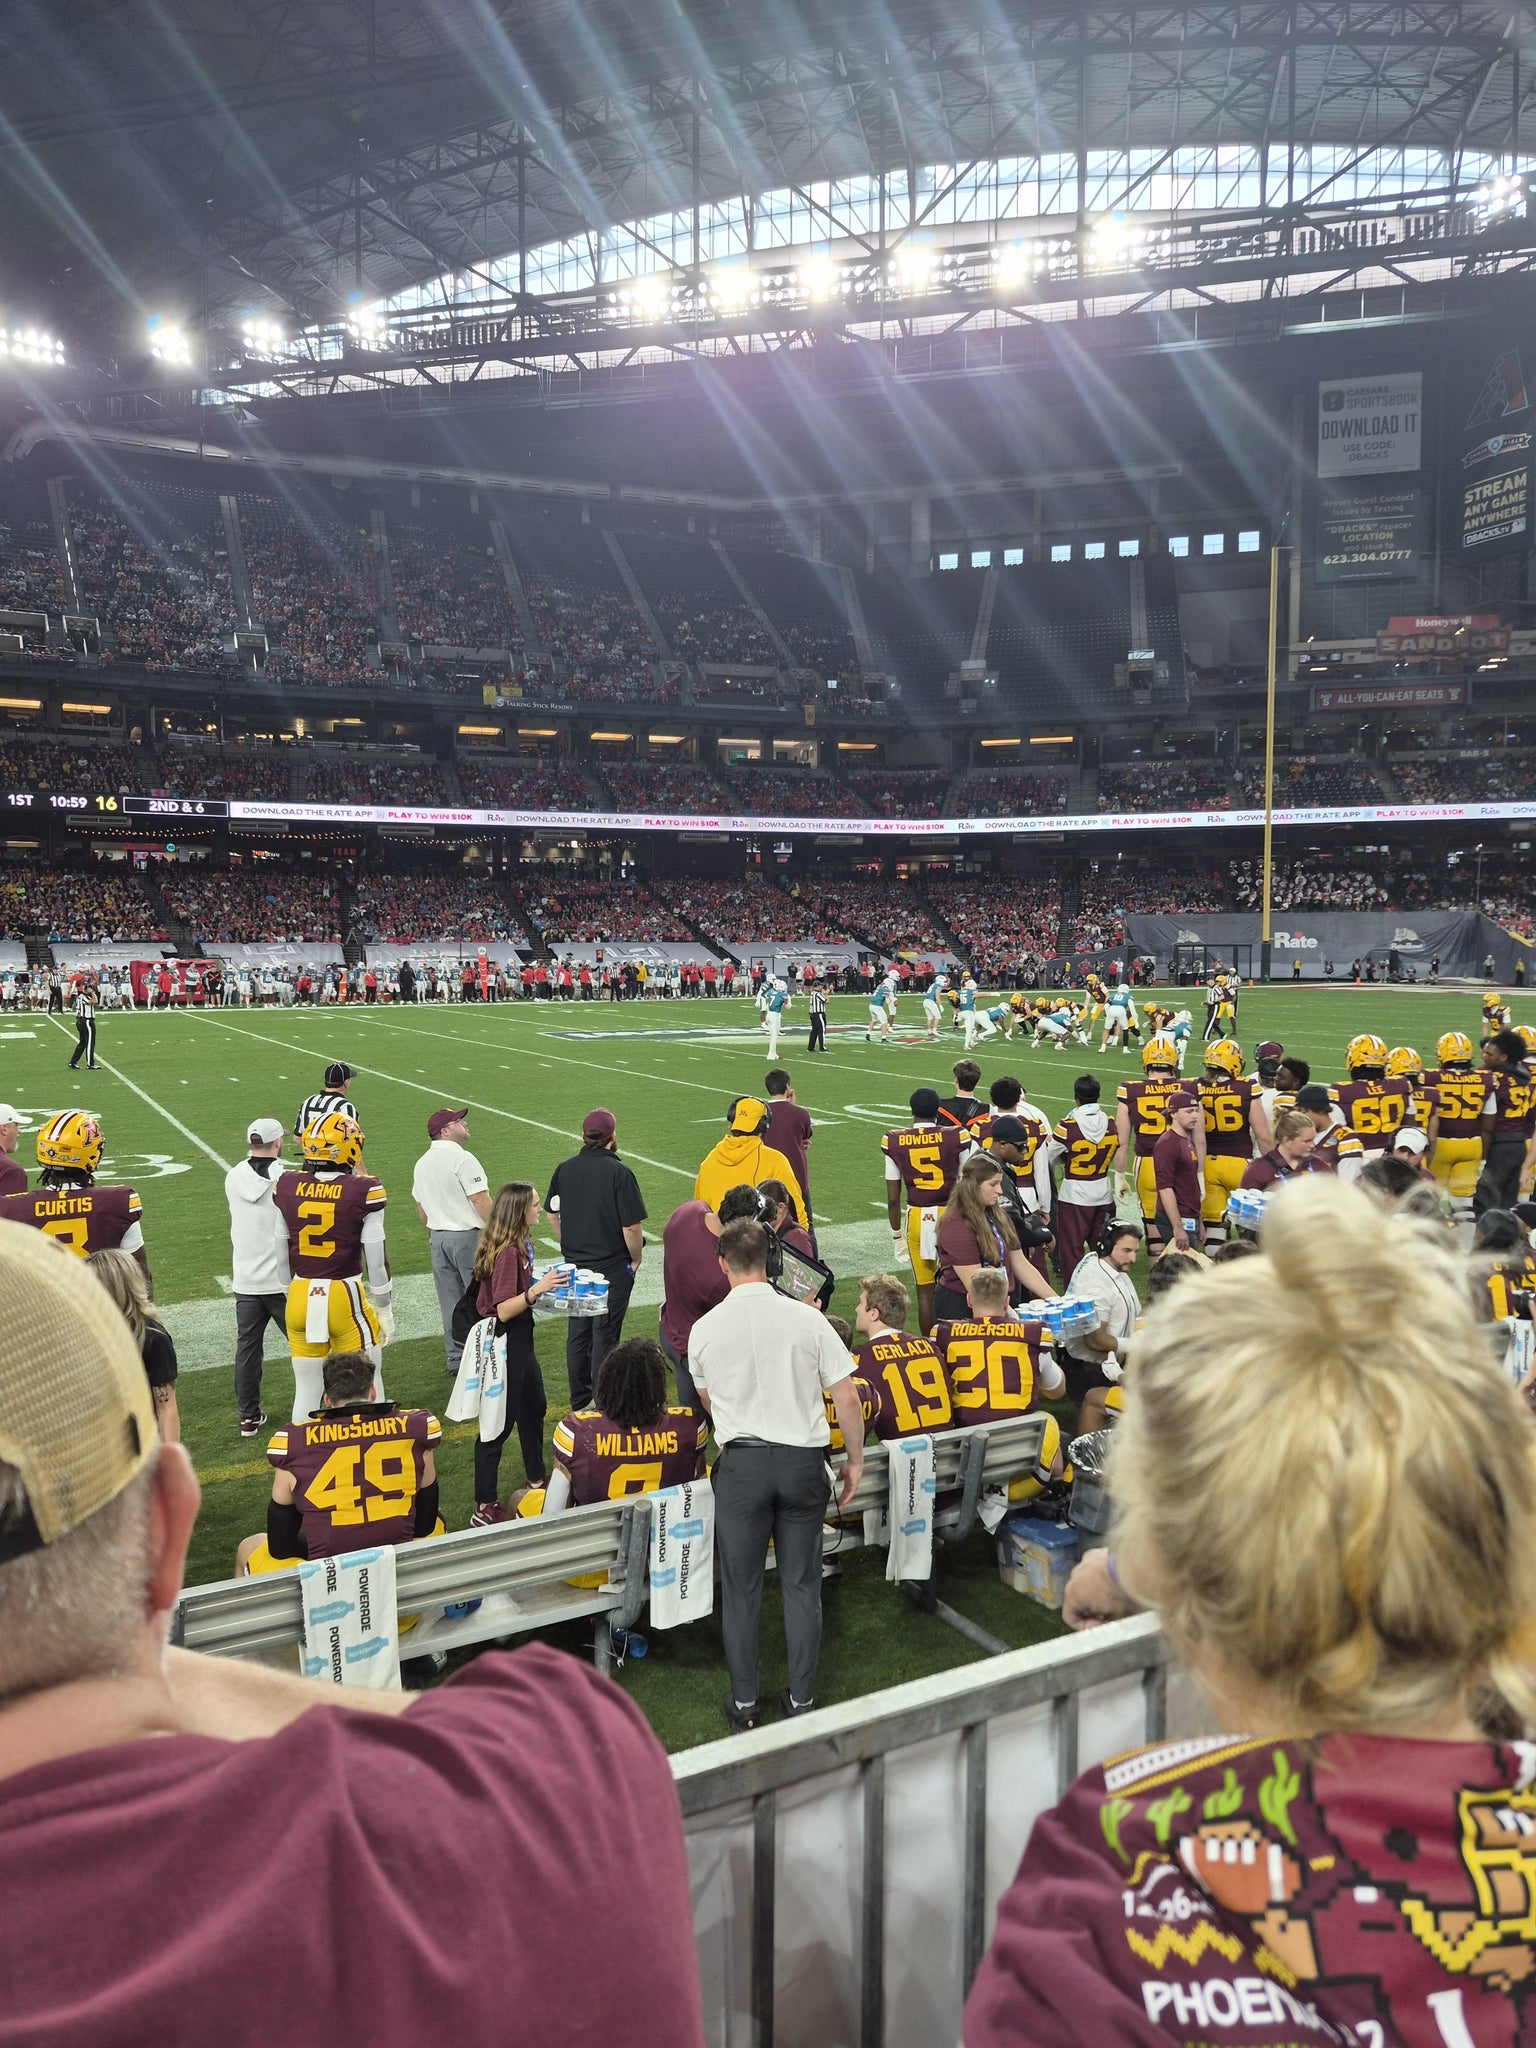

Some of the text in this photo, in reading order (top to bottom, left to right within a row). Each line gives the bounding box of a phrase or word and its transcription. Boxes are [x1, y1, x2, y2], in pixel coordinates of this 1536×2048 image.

[1346, 393, 1418, 410] SPORTSBOOK
[1321, 413, 1418, 440] DOWNLOAD IT
[1343, 442, 1362, 453] USE
[1348, 450, 1390, 461] DBACKS
[1464, 472, 1528, 504] STREAM
[1353, 496, 1377, 505] Guest
[1380, 493, 1415, 503] Conduct
[1464, 489, 1527, 518] ANY GAME
[1361, 507, 1372, 515] by
[1374, 504, 1404, 513] Texting
[1463, 503, 1527, 531] ANYWHERE
[1342, 531, 1394, 543] LOCATION
[1323, 549, 1412, 565] 623.304.0777
[1415, 689, 1444, 700] SEATS
[7, 794, 118, 811] 1ST 10:59 16
[148, 800, 205, 814] 2ND & 6
[242, 806, 303, 816] DOWNLOAD
[304, 808, 325, 817] THE
[326, 809, 353, 817] RATE
[354, 810, 373, 818] APP
[388, 811, 413, 819] PLAY
[415, 812, 428, 820] TO
[451, 813, 473, 821] $10K
[516, 815, 570, 823] DOWNLOAD
[571, 816, 589, 824] THE
[590, 817, 614, 825] RATE
[615, 817, 631, 825] APP
[644, 818, 667, 826] PLAY
[985, 821, 1036, 829] DOWNLOAD
[1038, 820, 1055, 828] THE
[1111, 818, 1135, 826] PLAY
[1151, 817, 1170, 825] WIN
[1236, 813, 1293, 822] DOWNOAD
[1295, 812, 1313, 820] THE
[1315, 811, 1341, 819] RATE
[1342, 811, 1361, 819] APP
[1420, 809, 1439, 817] WIN
[1442, 808, 1464, 816] $10K
[758, 821, 807, 829] DOWNLOAD
[873, 823, 894, 831] PLAY
[896, 823, 907, 831] TO
[1273, 931, 1319, 949] Rate
[1440, 1073, 1482, 1083] WILLIAMS
[1145, 1083, 1183, 1095] ALVAREZ
[1366, 1085, 1386, 1096] LEE
[1435, 1083, 1486, 1119] 55
[1136, 1095, 1172, 1135] 5
[1351, 1094, 1405, 1134] 60
[898, 1131, 943, 1147] BOWDEN
[1069, 1134, 1119, 1176] 27
[908, 1146, 945, 1191] 5
[296, 1181, 342, 1200] KARMO
[34, 1196, 93, 1217] CURTIS
[297, 1200, 336, 1259] 2
[950, 1321, 1025, 1339] ROBERSON
[475, 1324, 483, 1375] POWERADE
[871, 1338, 934, 1362] GERLACH
[946, 1339, 1033, 1411] 20
[881, 1356, 952, 1433] 19
[305, 1414, 408, 1446] KINGSBURY
[595, 1430, 678, 1457] WILLIAMS
[304, 1439, 416, 1527] 49
[659, 1500, 668, 1563] POWERADE
[680, 1541, 691, 1601] POWERADE
[358, 1567, 371, 1635] POWERADE
[329, 1625, 343, 1686] POWERAD
